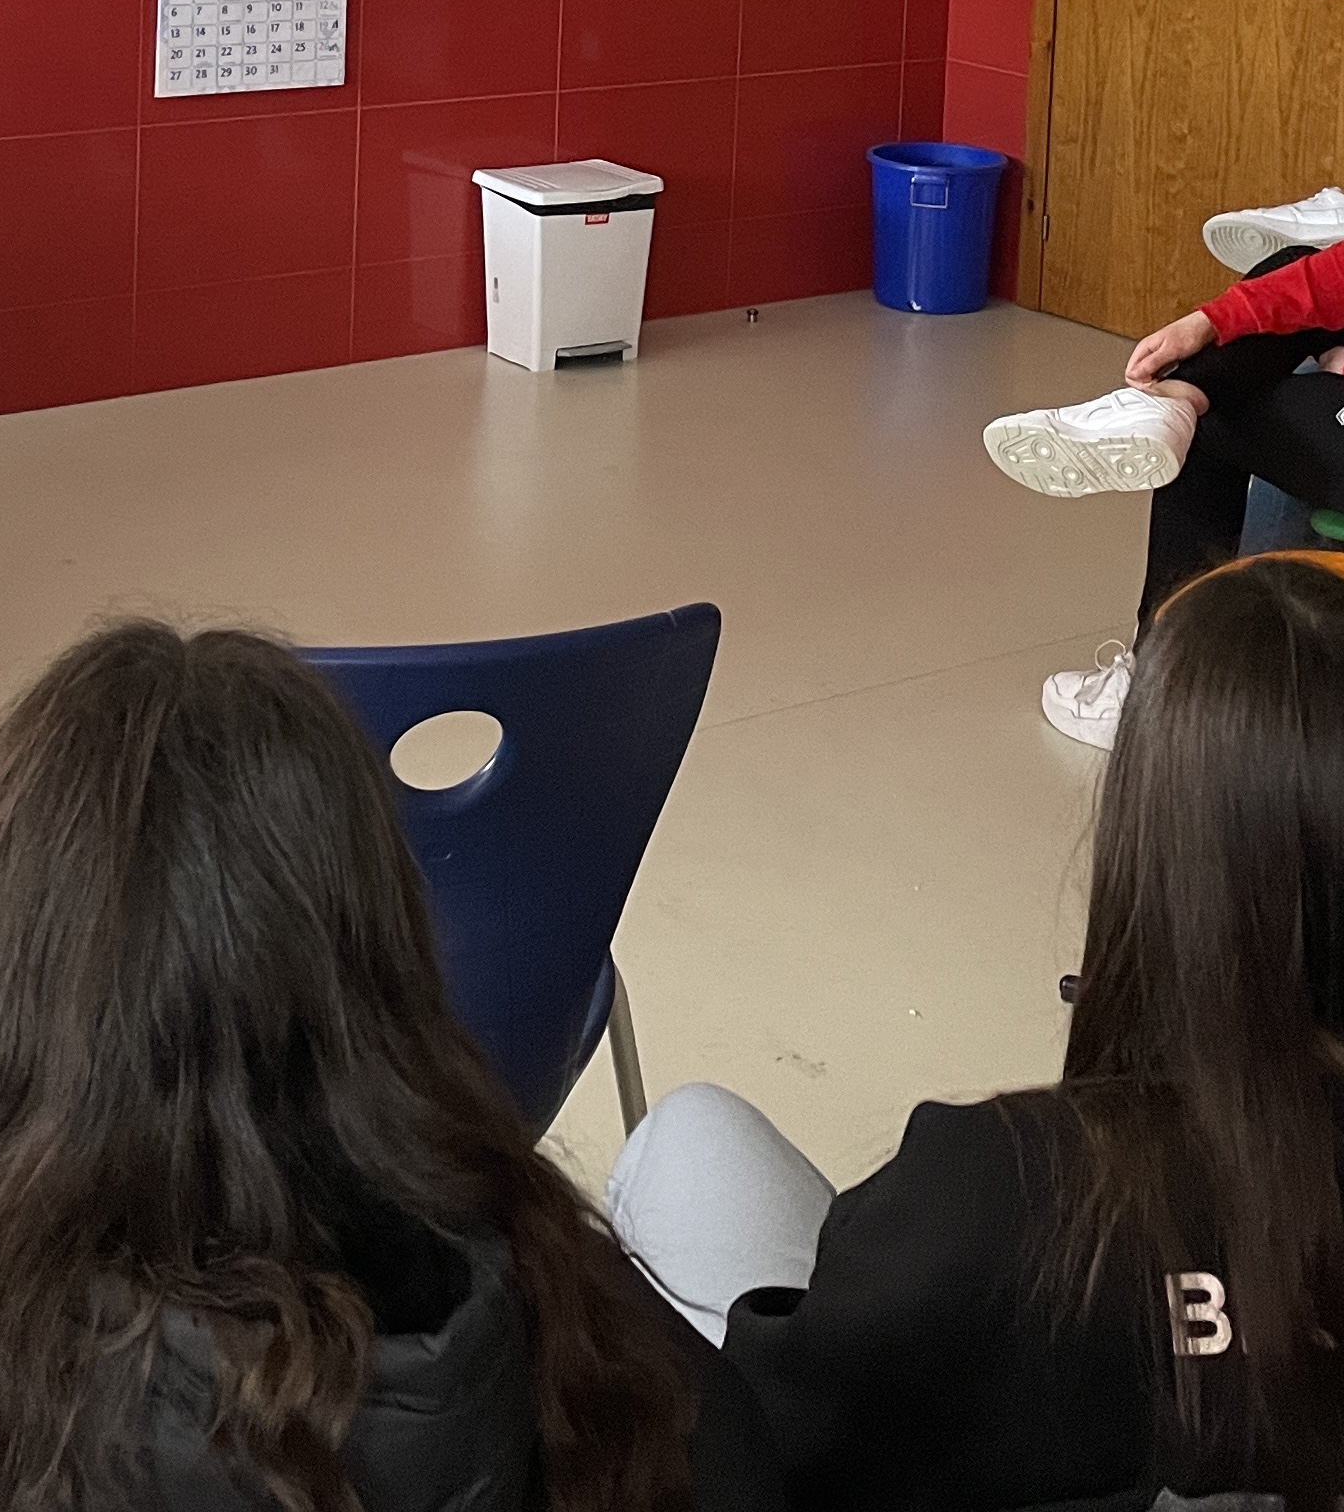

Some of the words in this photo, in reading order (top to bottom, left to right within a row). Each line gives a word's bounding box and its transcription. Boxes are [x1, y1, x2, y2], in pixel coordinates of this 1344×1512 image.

[171, 7, 177, 17] 6
[197, 7, 202, 15] 7
[222, 6, 228, 14] 8
[247, 5, 253, 13] 9
[272, 3, 282, 12] 10
[296, 2, 303, 11] 11
[320, 1, 328, 10] 12
[171, 29, 180, 38] 13
[196, 27, 205, 36] 14
[221, 26, 230, 35] 15
[246, 25, 256, 34] 16
[271, 23, 280, 32] 17
[295, 22, 304, 31] 18
[171, 50, 182, 59] 20
[196, 49, 205, 57] 21
[221, 47, 232, 56] 22
[246, 46, 257, 54] 23
[271, 44, 282, 53] 24
[295, 43, 305, 51] 25
[170, 71, 181, 80] 27
[196, 70, 207, 78] 28
[221, 68, 232, 77] 29
[245, 66, 257, 75] 30
[270, 65, 279, 74] 31
